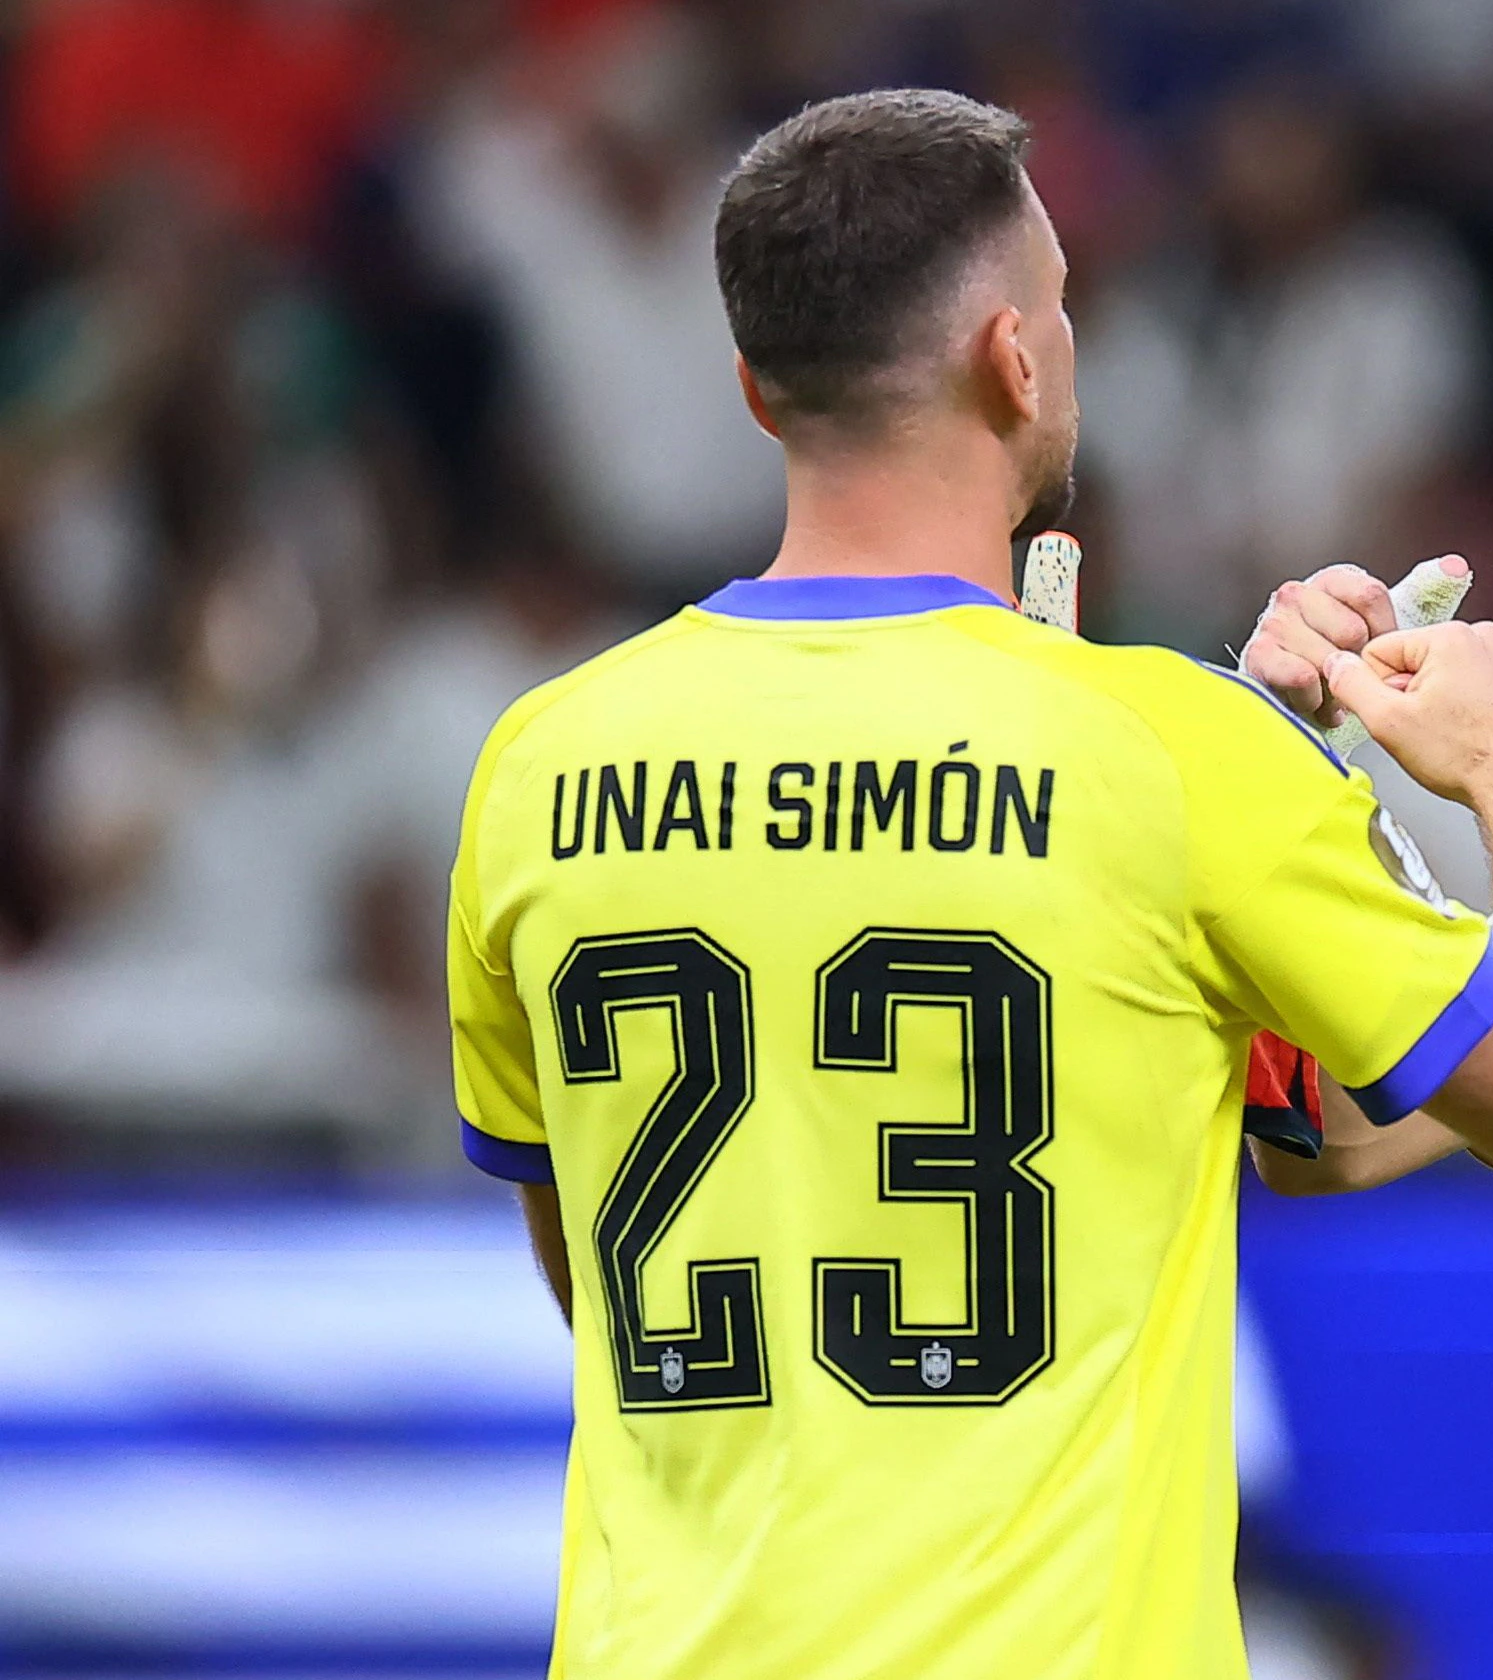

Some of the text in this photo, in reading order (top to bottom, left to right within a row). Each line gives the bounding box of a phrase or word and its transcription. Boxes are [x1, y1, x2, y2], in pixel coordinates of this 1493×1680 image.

[551, 740, 1054, 860] UNAI SIMÓN
[548, 926, 1055, 1414] 23
